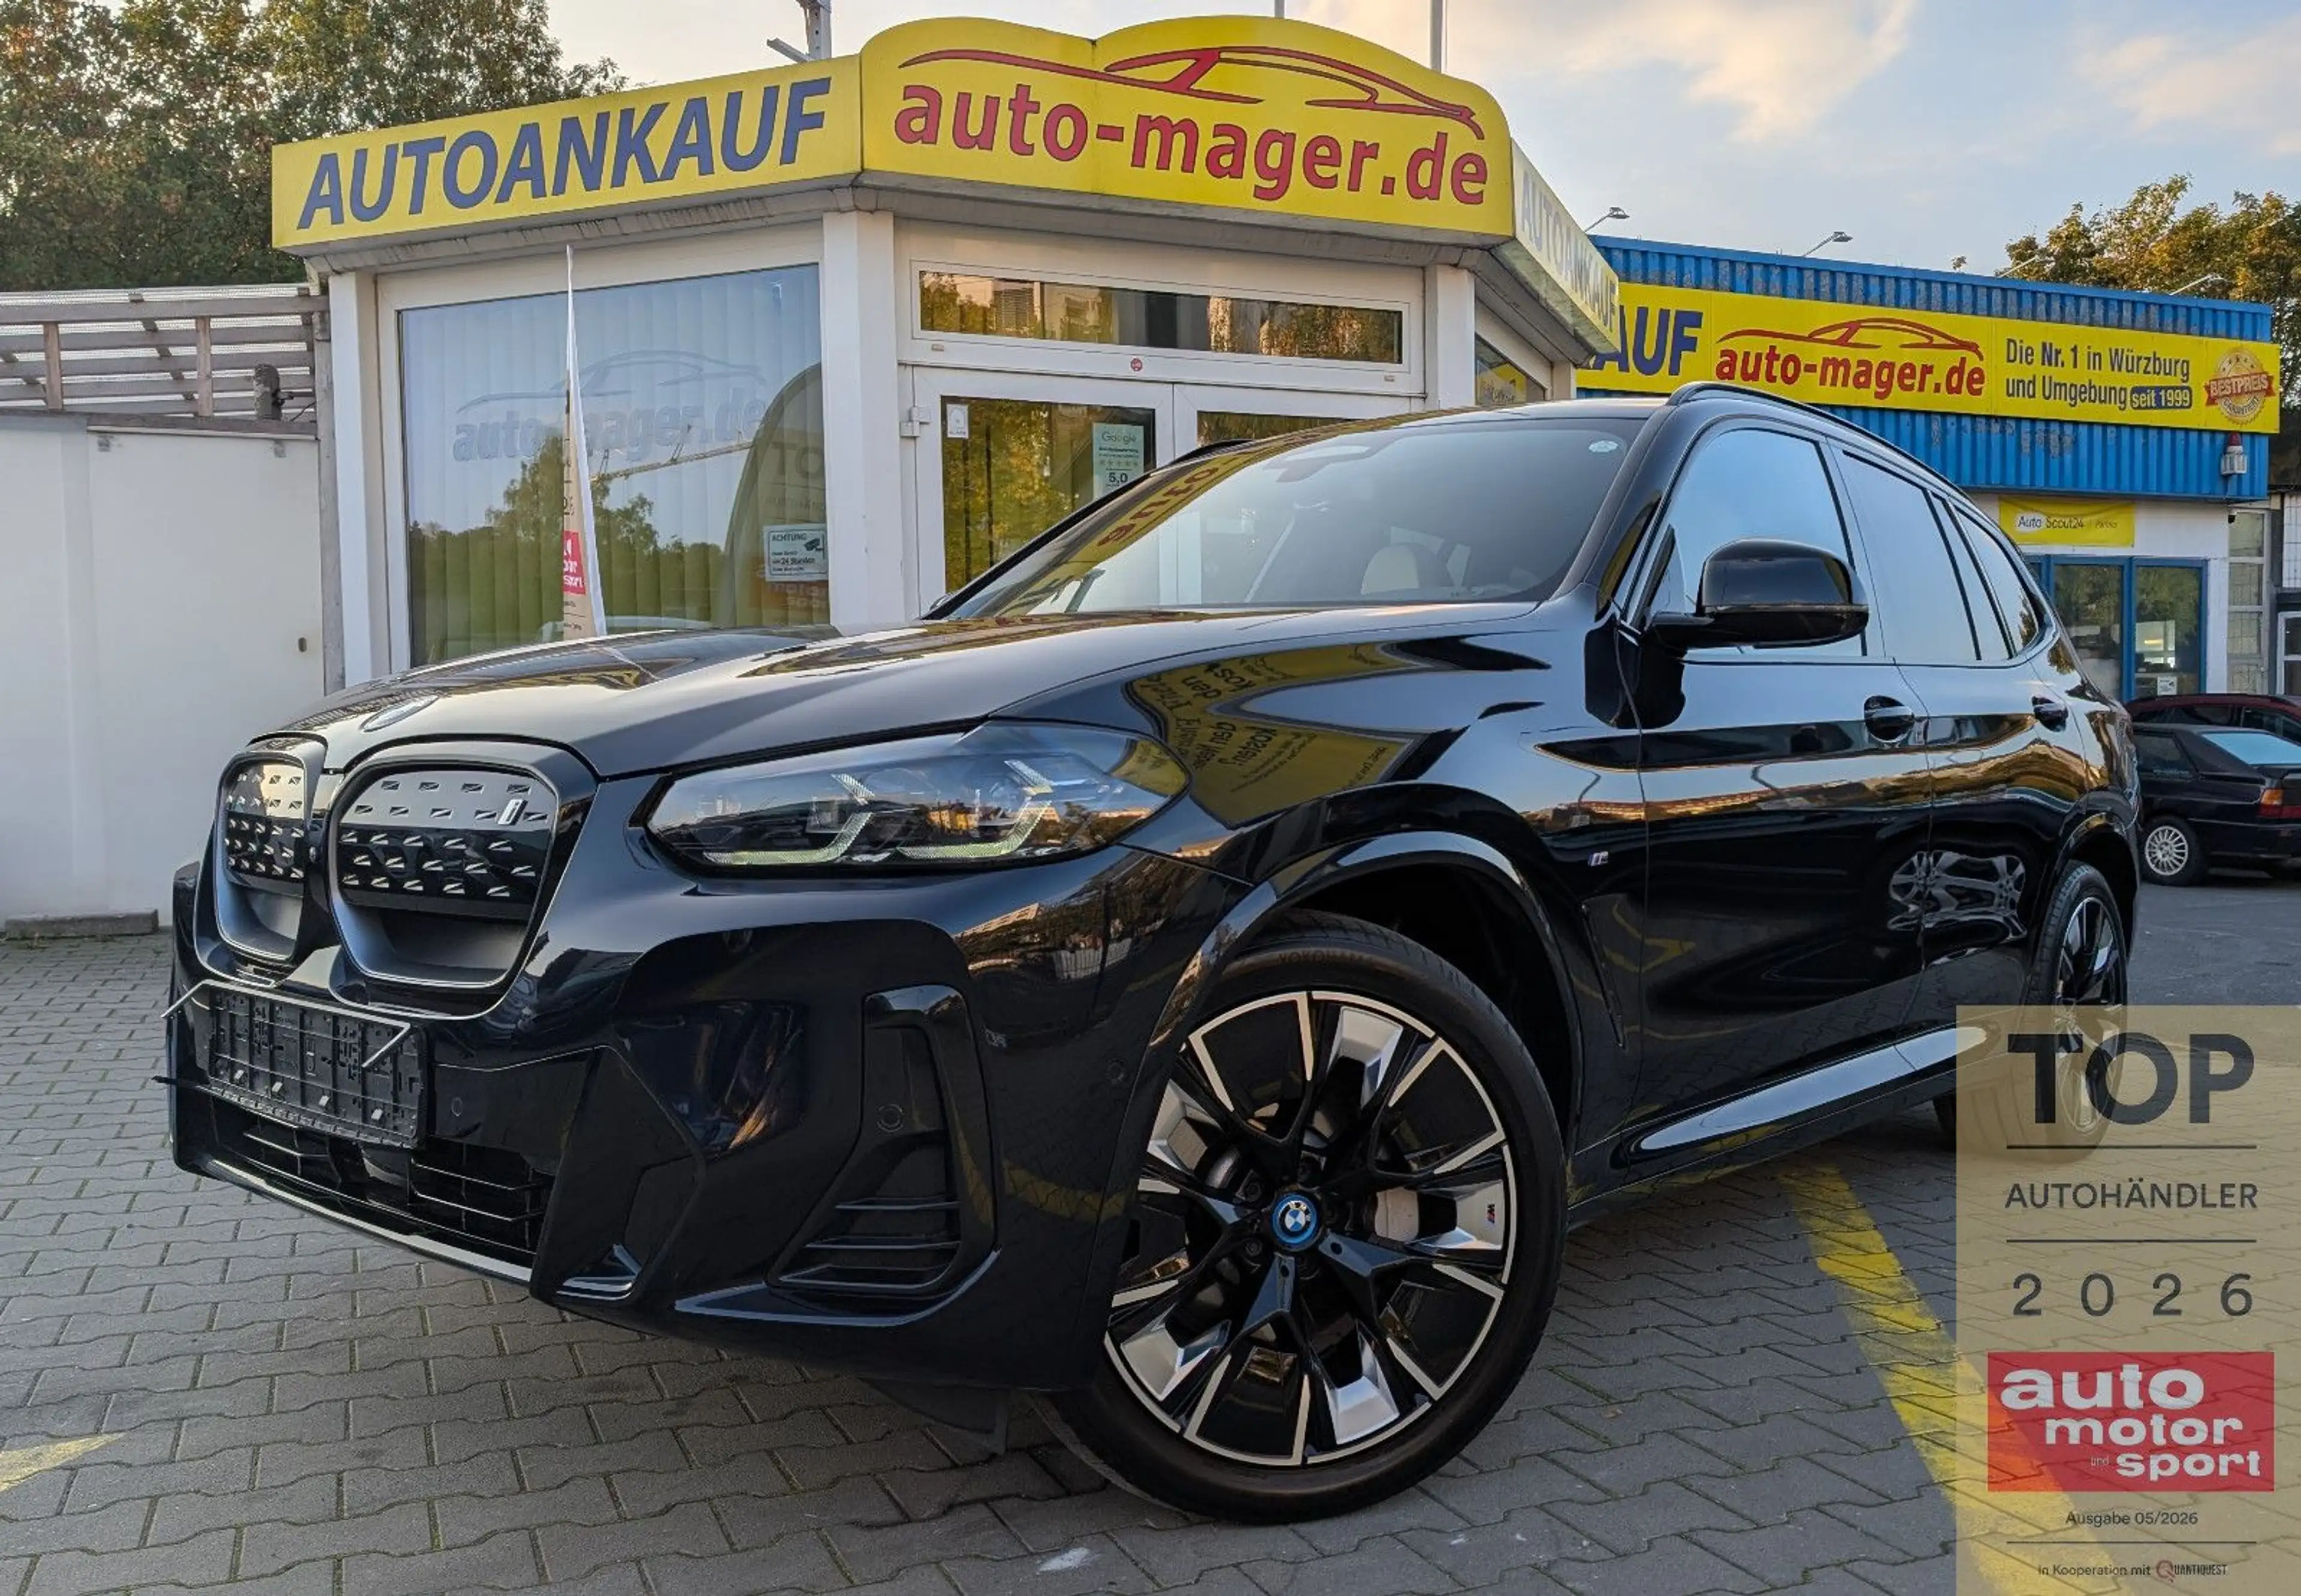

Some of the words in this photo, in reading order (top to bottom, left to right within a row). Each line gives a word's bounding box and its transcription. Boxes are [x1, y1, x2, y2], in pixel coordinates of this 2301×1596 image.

[297, 77, 830, 230] AUTOANKAUF
[895, 84, 1488, 204] auto-mager.de
[1716, 345, 1985, 400] auto-mager.de
[2006, 338, 2034, 365] Die
[2041, 341, 2065, 368] Nr.
[2070, 344, 2078, 368] 1
[2087, 346, 2102, 371] in
[2109, 347, 2190, 383] Würzburg
[2006, 374, 2036, 399] und
[2042, 375, 2127, 411] Umgebung
[2132, 390, 2156, 408] seit
[2160, 389, 2190, 408] 1999
[2210, 374, 2269, 397] BESTPREIS
[1101, 431, 1137, 445] Google
[1109, 471, 1128, 483] 5,0
